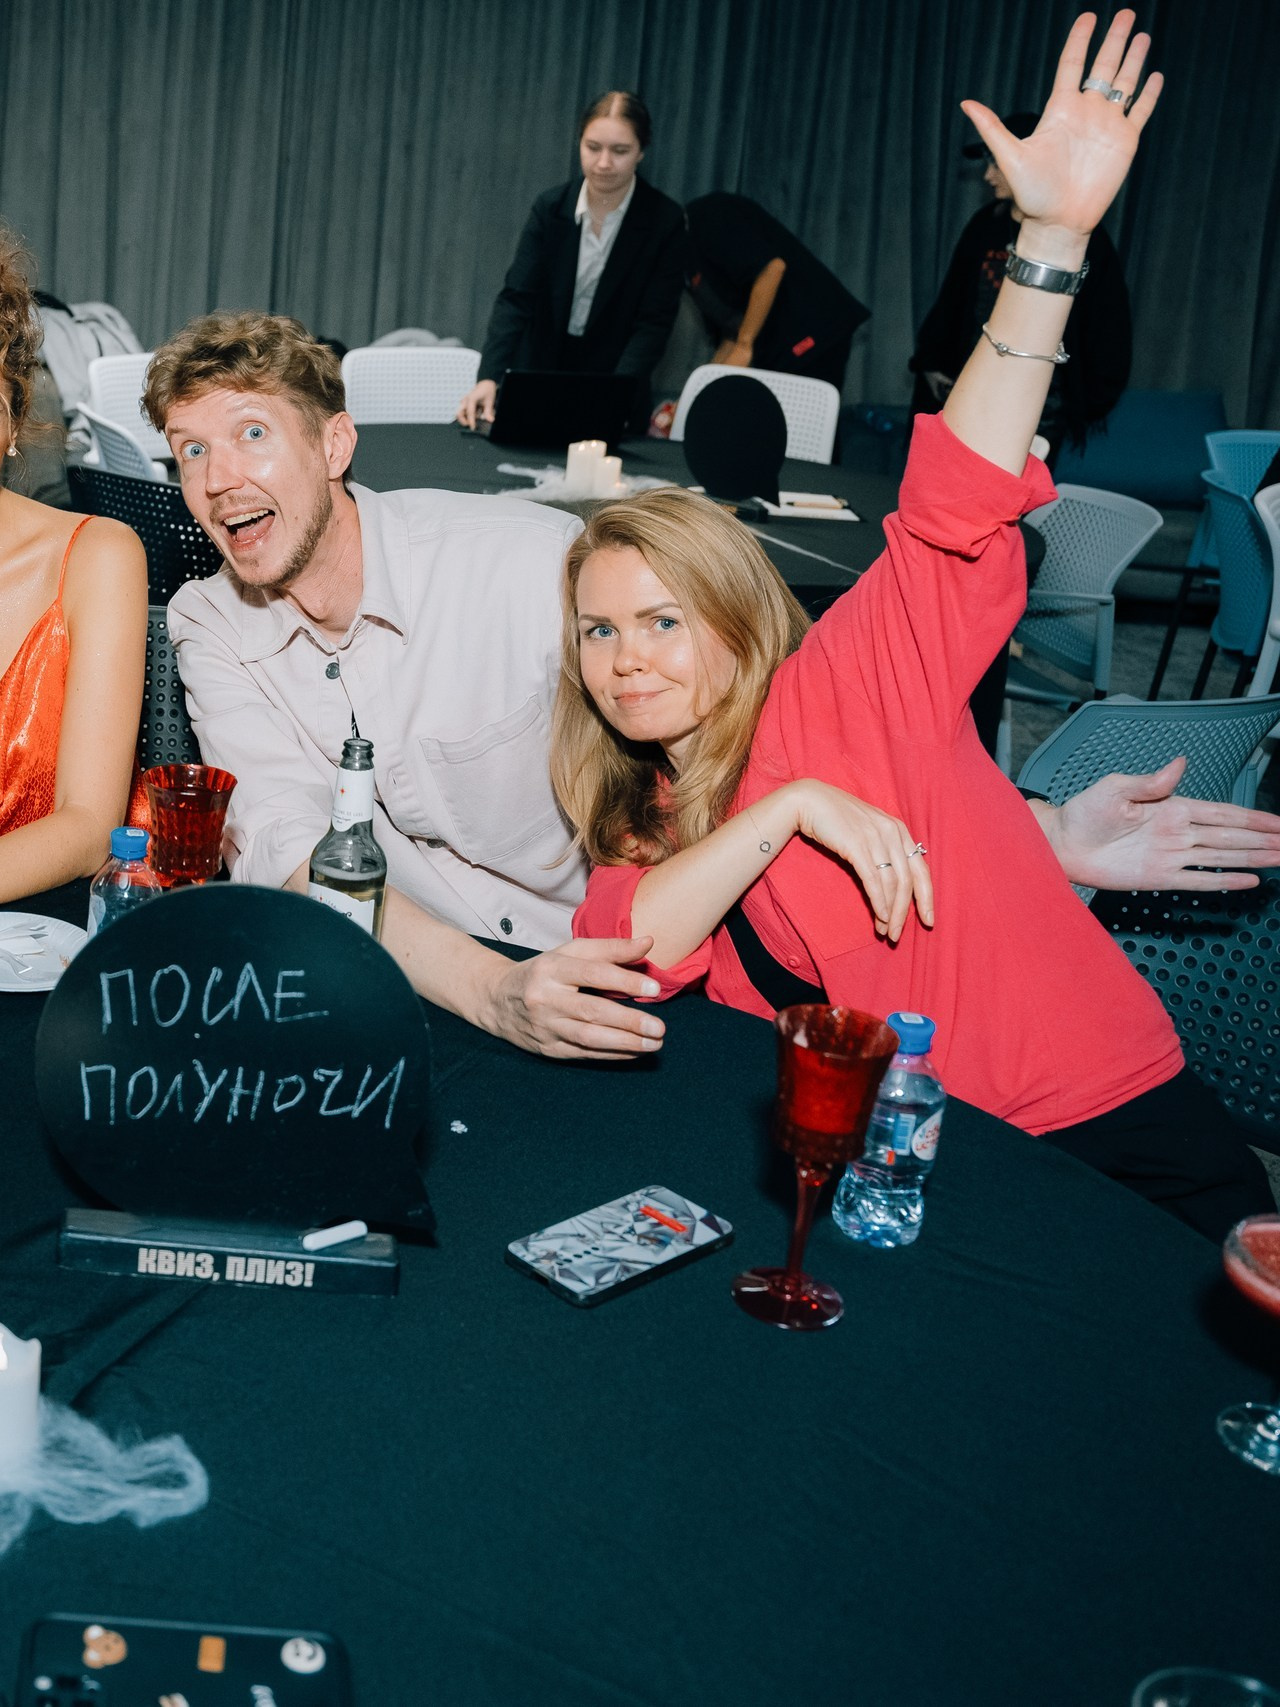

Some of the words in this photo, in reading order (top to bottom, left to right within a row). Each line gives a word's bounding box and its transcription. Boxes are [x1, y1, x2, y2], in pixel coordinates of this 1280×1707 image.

[100, 962, 330, 1034] ПОСЛЕ
[80, 1057, 406, 1129] ПОЛУНОЧИ
[137, 1247, 220, 1282] КВИЗ,
[225, 1256, 316, 1287] ПЛИЗ!
